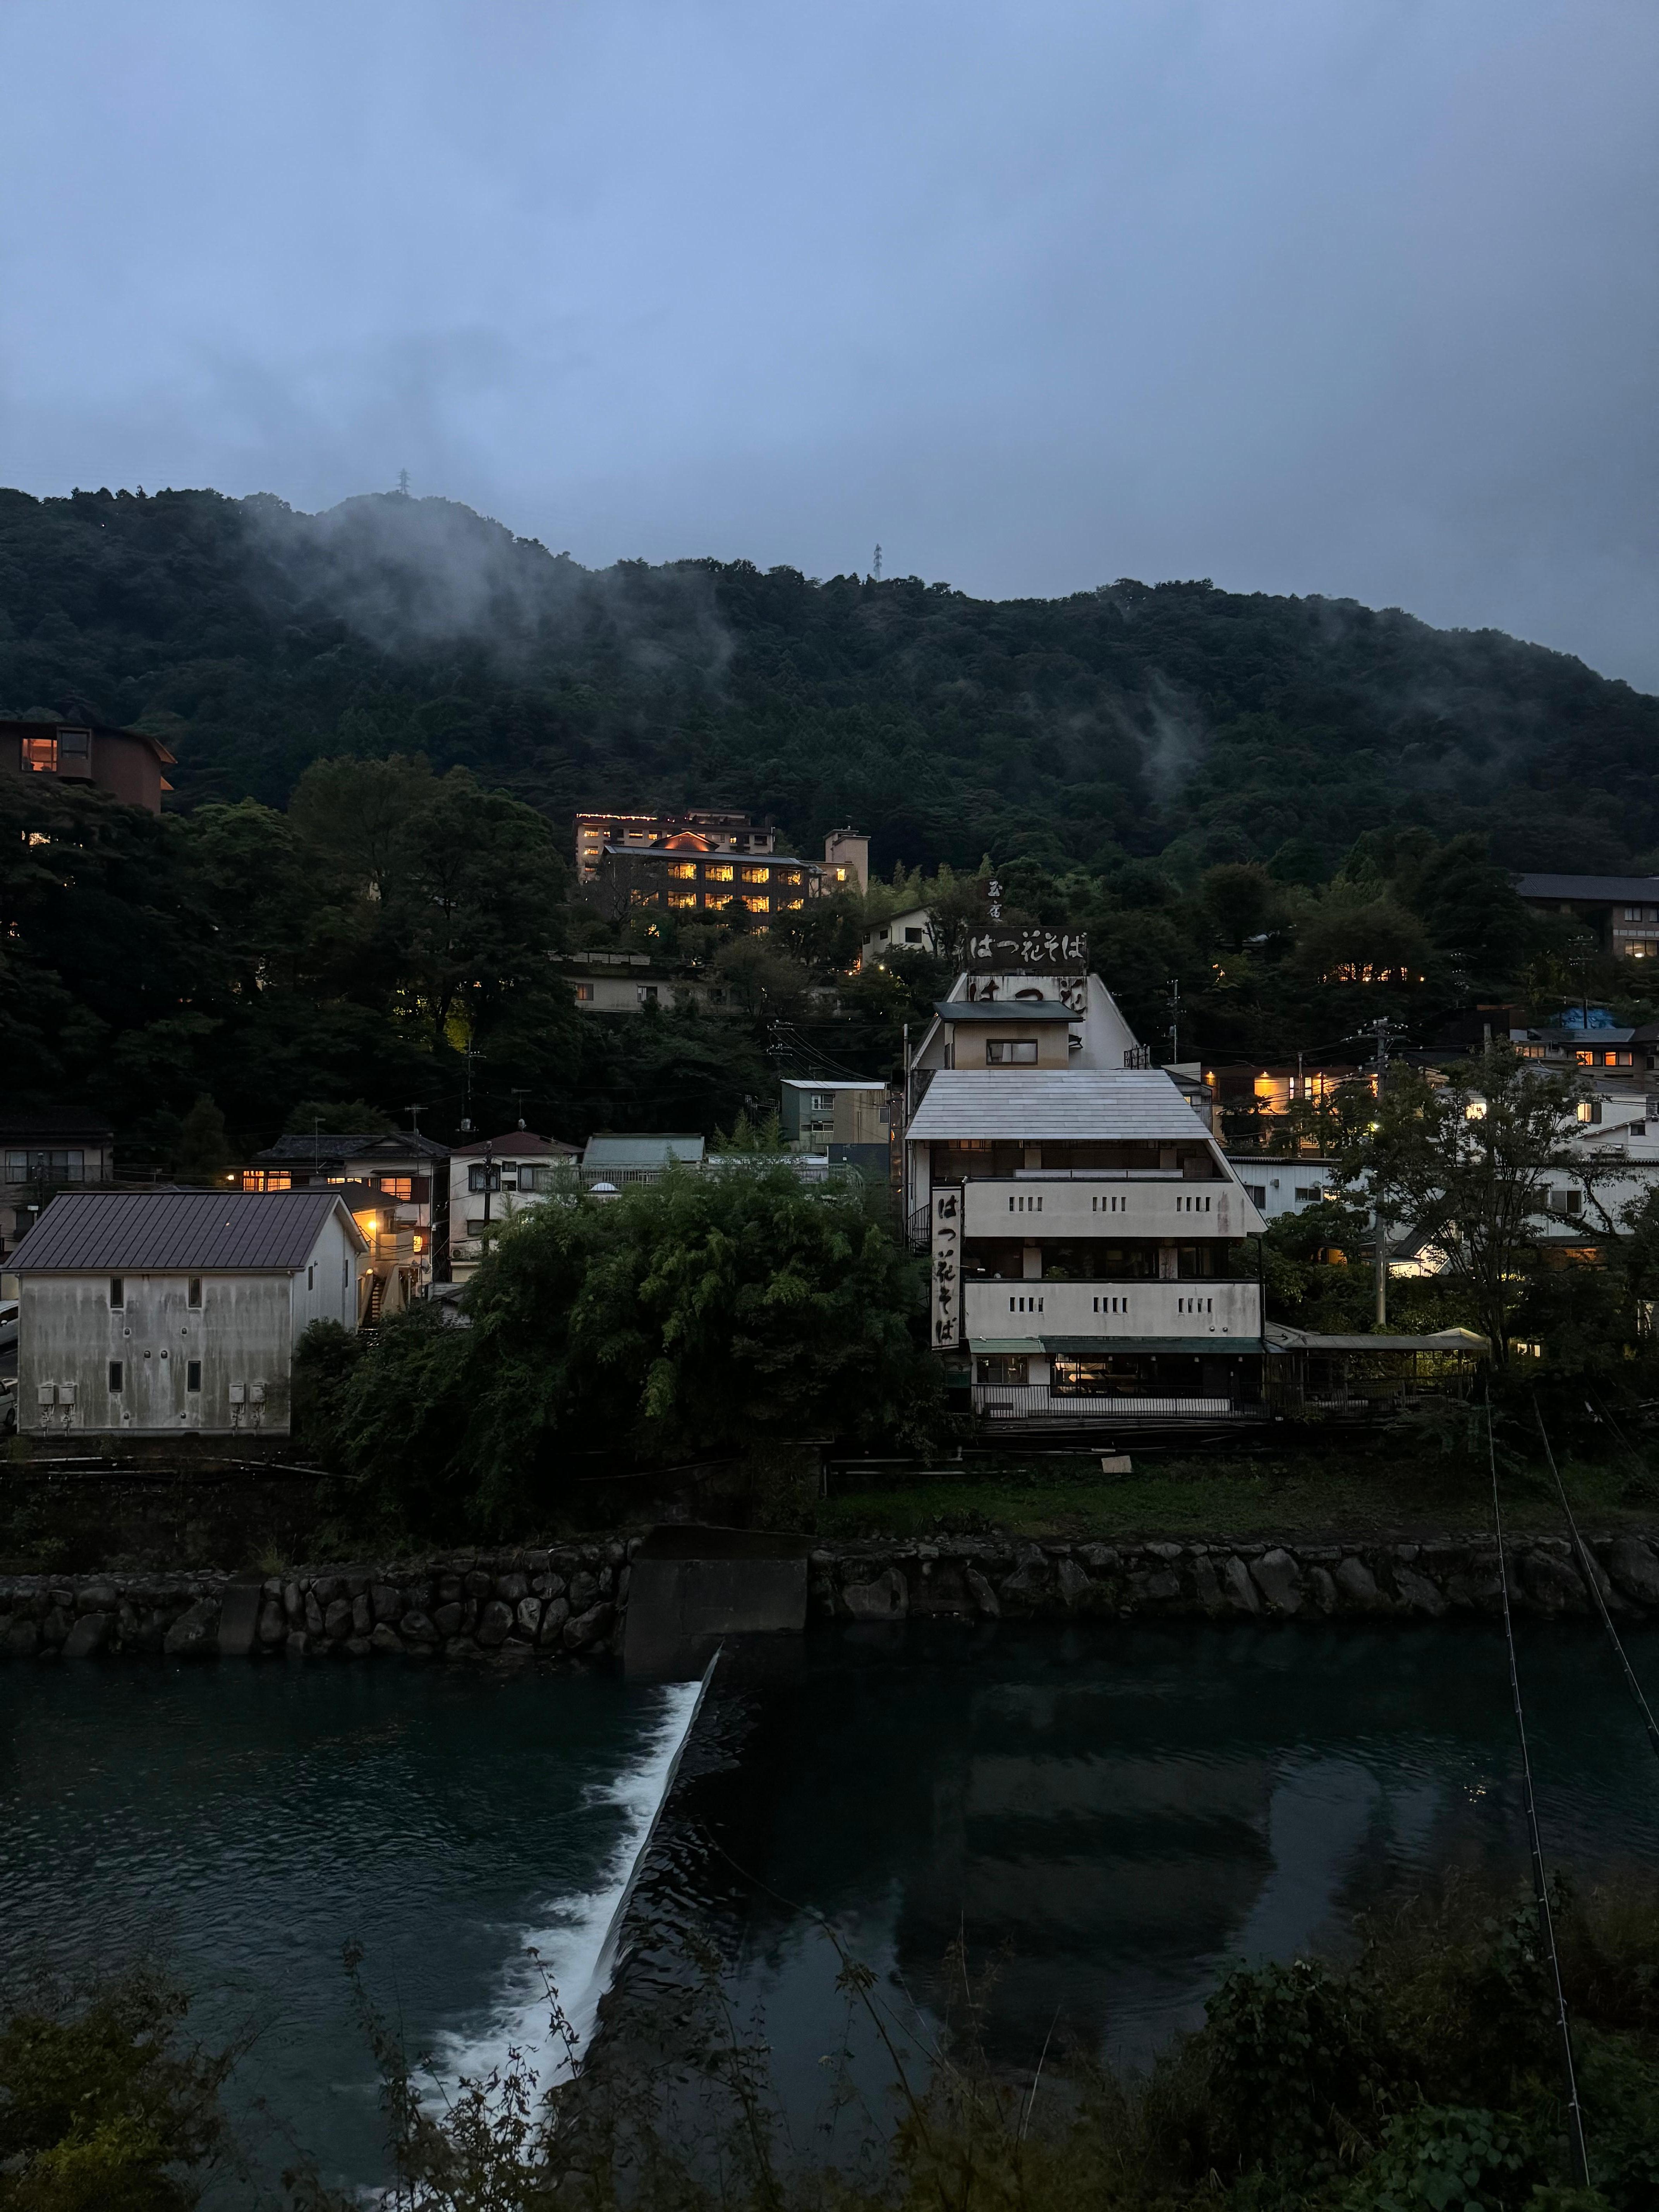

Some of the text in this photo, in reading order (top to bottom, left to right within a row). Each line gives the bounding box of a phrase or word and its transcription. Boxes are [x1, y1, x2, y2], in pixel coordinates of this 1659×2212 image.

[970, 929, 1087, 962] はつ花そば
[936, 1195, 959, 1344] はつ花そば
